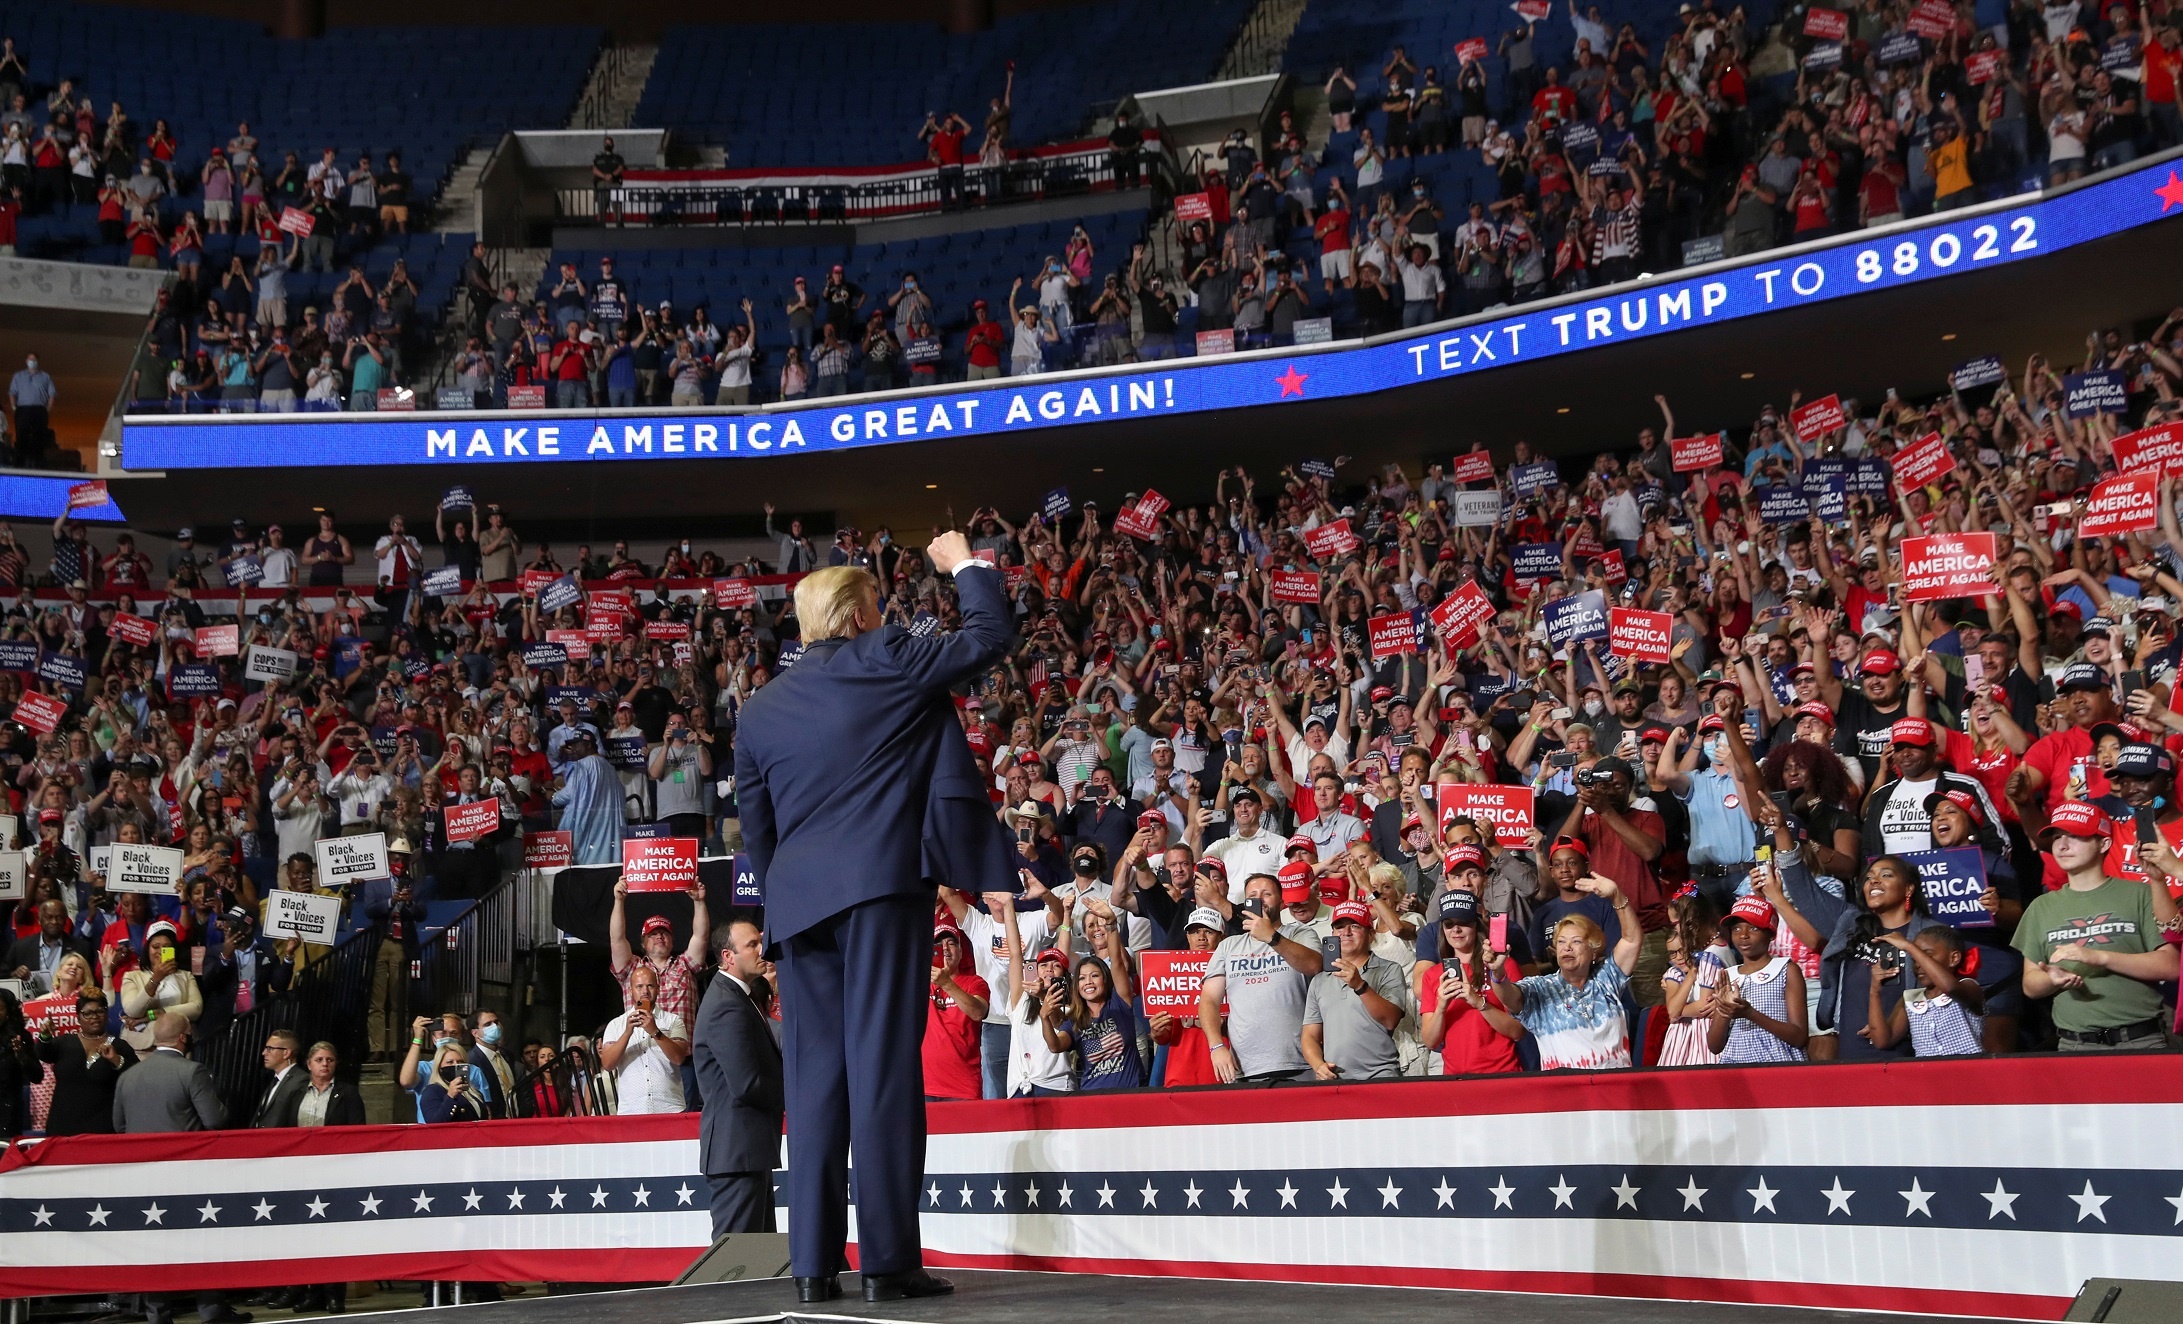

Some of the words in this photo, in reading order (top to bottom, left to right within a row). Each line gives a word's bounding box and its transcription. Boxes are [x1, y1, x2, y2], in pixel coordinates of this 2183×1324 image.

[1408, 323, 1526, 376] TEXT
[1552, 282, 1727, 346] TRUMP
[1755, 262, 1825, 304] TO
[1857, 216, 2038, 284] 88022
[2084, 376, 2109, 387] MAKE
[2069, 383, 2124, 402] AMERICA
[1804, 404, 1824, 416] MAKE
[2070, 401, 2099, 412] GREAT
[2102, 397, 2126, 406] AGAIN
[428, 428, 559, 457] MAKE
[587, 420, 806, 454] AMERICA
[831, 400, 980, 442] GREAT
[1006, 379, 1174, 424] AGAIN!
[1798, 407, 1840, 429] AMERICA
[1800, 424, 1820, 438] GREAT
[1820, 416, 1842, 430] AGAIN
[1686, 440, 1706, 449] MAKE
[2138, 432, 2172, 449] MAKE
[1676, 445, 1718, 459] AMERICA
[1464, 456, 1478, 464] MAKE
[1676, 457, 1698, 466] GREAT
[1698, 452, 1720, 462] AGAIN
[1456, 460, 1489, 474] AMERICA
[1526, 466, 1544, 474] MAKE
[1820, 464, 1842, 472] MAKE
[1456, 470, 1474, 479] GREAT
[1474, 468, 1490, 476] AGAIN
[1517, 472, 1558, 486] AMERICA
[1518, 482, 1537, 491] GREAT
[1539, 478, 1558, 487] AGAIN
[2105, 482, 2134, 494] MAKE
[1772, 492, 1793, 500] MAKE
[1045, 496, 1068, 512] AMERICA
[1464, 500, 1500, 511] VETERANS
[1761, 498, 1808, 510] AMERICA
[2087, 492, 2152, 514] AMERICA
[1785, 508, 1810, 516] AGAIN
[2083, 514, 2118, 526] GREAT
[2120, 508, 2154, 522] AGAIN
[1318, 527, 1336, 537] MAKE
[1310, 530, 1350, 548] AMERICA
[1312, 545, 1332, 554] GREAT
[1332, 538, 1352, 550] AGAIN
[1524, 548, 1546, 556] MAKE
[1926, 542, 1964, 556] MAKE
[1514, 556, 1561, 567] AMERICA
[1906, 556, 1990, 576] AMERICA
[1274, 581, 1318, 591] AMERICA
[1907, 576, 1948, 590] GREAT
[1950, 571, 1991, 586] AGAIN
[548, 582, 564, 593] MAKE
[1274, 589, 1296, 597] GREAT
[1296, 590, 1318, 598] AGAIN
[542, 584, 576, 604] AMERICA
[602, 596, 618, 604] MAKE
[542, 598, 560, 610] GREAT
[560, 592, 577, 604] AGAIN
[592, 602, 628, 612] AMERICA
[1445, 595, 1466, 615] MAKE
[1439, 594, 1485, 630] AMERICA
[1558, 602, 1583, 616] MAKE
[1387, 617, 1410, 627] MAKE
[1446, 621, 1467, 639] GREAT
[1464, 603, 1490, 623] AGAIN
[1549, 609, 1604, 633] AMERICA
[1626, 616, 1652, 627] MAKE
[1552, 630, 1573, 643] GREAT
[1574, 622, 1606, 636] AGAIN
[1613, 627, 1668, 643] AMERICA
[1375, 638, 1402, 650] GREAT
[1613, 639, 1635, 650] GREAT
[1636, 643, 1668, 654] AGAIN
[254, 654, 276, 666] COPS
[525, 649, 566, 659] AMERICA
[42, 663, 84, 679] AMERICA
[61, 674, 82, 686] AGAIN
[173, 676, 218, 684] AMERICA
[1468, 795, 1504, 805] MAKE
[1884, 797, 1916, 811] Black
[462, 807, 484, 816] MAKE
[2064, 803, 2094, 816] AMERICA
[450, 812, 496, 828] AMERICA
[450, 824, 475, 834] GREAT
[476, 820, 497, 830] AGAIN
[1902, 824, 1930, 832] TRUM
[328, 843, 354, 856] Black
[525, 844, 569, 854] AMERICA
[644, 846, 674, 856] MAKE
[1460, 846, 1481, 855] AMERICA
[122, 850, 150, 863] Black
[344, 852, 374, 864] Voices
[1464, 852, 1480, 860] AGAIN
[137, 862, 170, 875] Voices
[332, 866, 350, 874] FOR
[351, 864, 374, 872] TRUMP
[626, 858, 694, 871] AMERICA
[123, 874, 140, 882] FOR
[142, 876, 168, 884] TRUMP
[626, 872, 662, 882] GREAT
[663, 872, 694, 881] AGAIN
[1452, 894, 1474, 902] AMERICA
[1744, 897, 1768, 910] AMERICA
[280, 898, 308, 911] Black
[1456, 902, 1472, 910] AGAIN
[294, 910, 325, 924] Voices
[280, 922, 296, 930] FOR
[298, 924, 322, 934] TRUMP
[2048, 922, 2136, 941] PROJECTS
[1170, 962, 1208, 972] MAKE
[1230, 955, 1287, 971] TRUMP
[1240, 969, 1268, 977] AMERICA
[1268, 966, 1290, 974] GREAT!
[1245, 976, 1269, 985] 2020
[1147, 995, 1188, 1006] GREAT
[46, 1005, 76, 1015] MAKE
